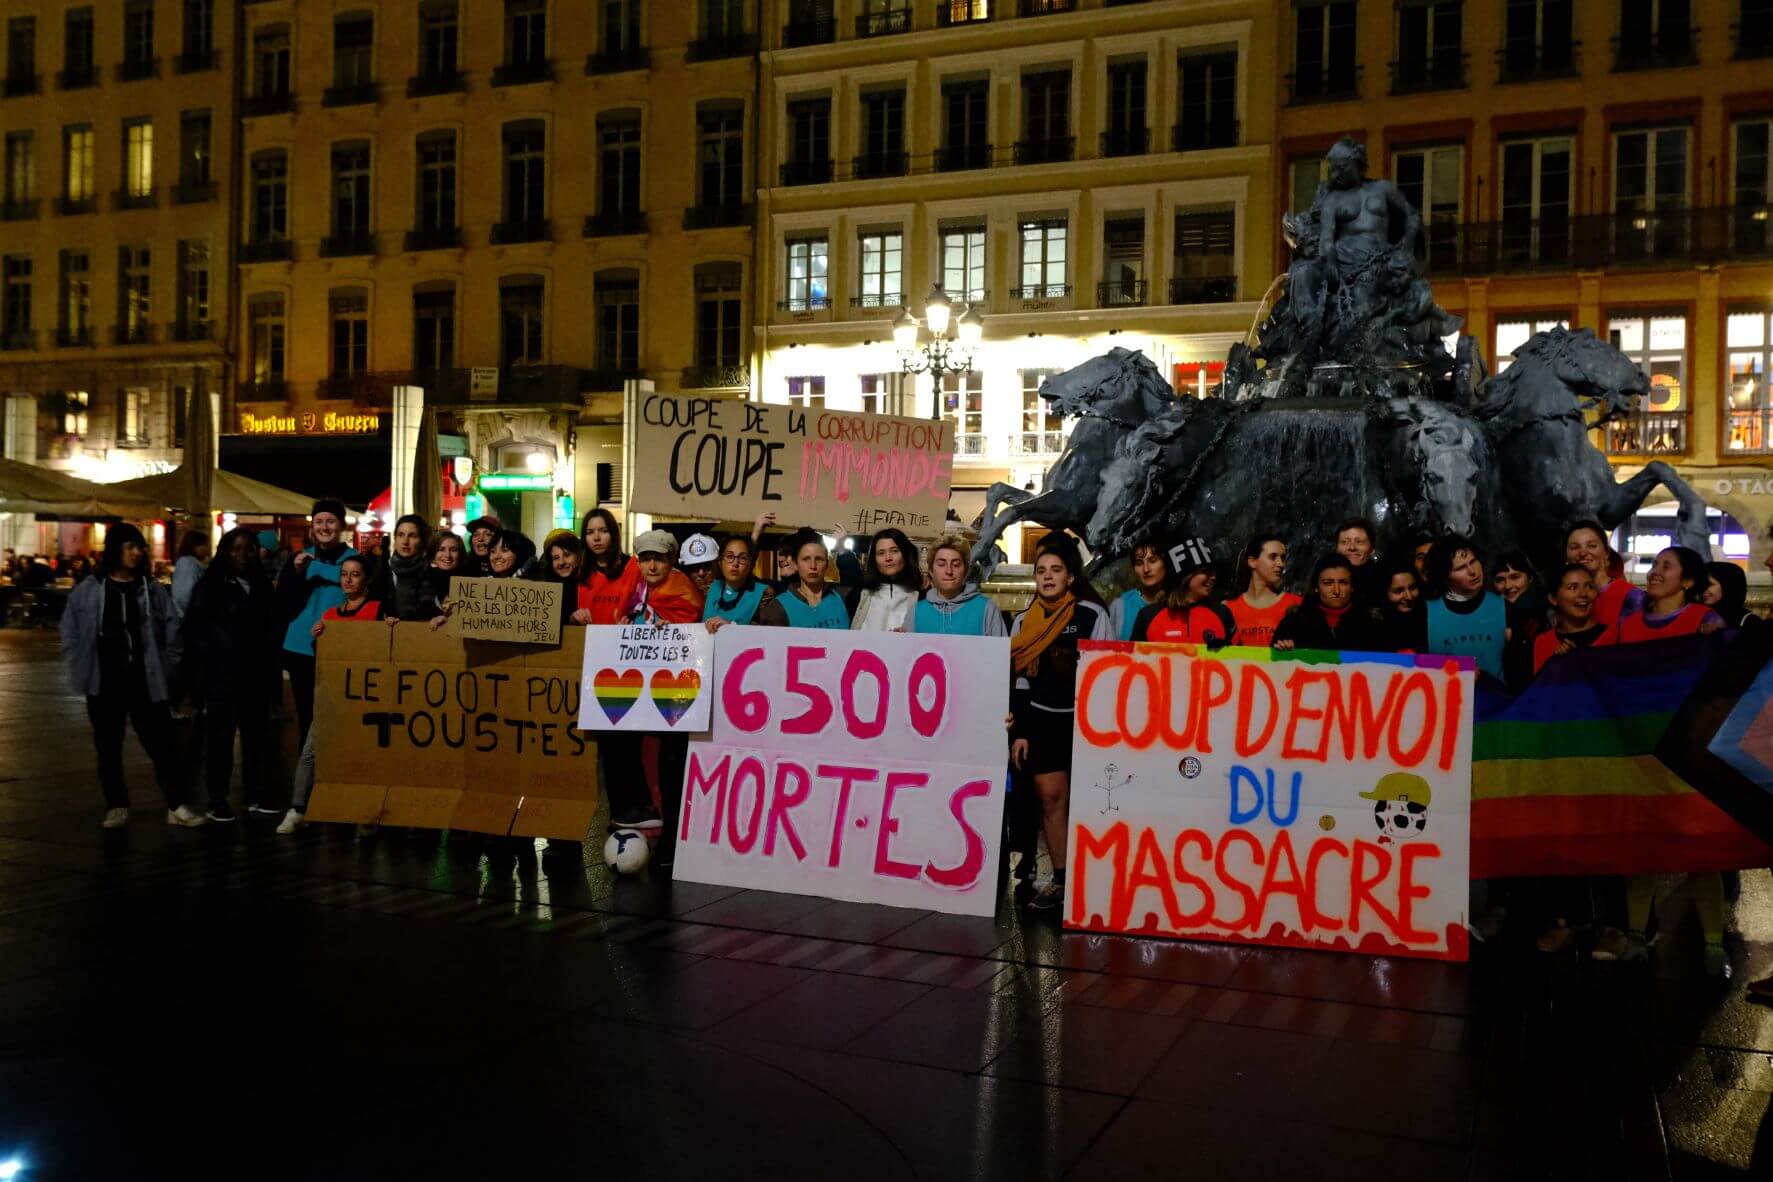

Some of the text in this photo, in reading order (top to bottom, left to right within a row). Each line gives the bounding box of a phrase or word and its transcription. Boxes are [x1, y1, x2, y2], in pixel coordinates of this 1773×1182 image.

[643, 395, 944, 450] COUPE DE LA CORRUPTION
[668, 429, 951, 503] COUPE IMMONDE
[457, 599, 550, 620] PAS LES DROITS
[459, 582, 554, 607] NE LAISSONS
[462, 617, 547, 633] HUMAINS HORS
[534, 632, 556, 641] JEU
[619, 644, 679, 662] TOUTES LES
[345, 668, 580, 716] LE FOOT POU
[721, 645, 947, 739] 6500
[1228, 764, 1303, 828] DU
[1071, 820, 1442, 945] MASSACRE
